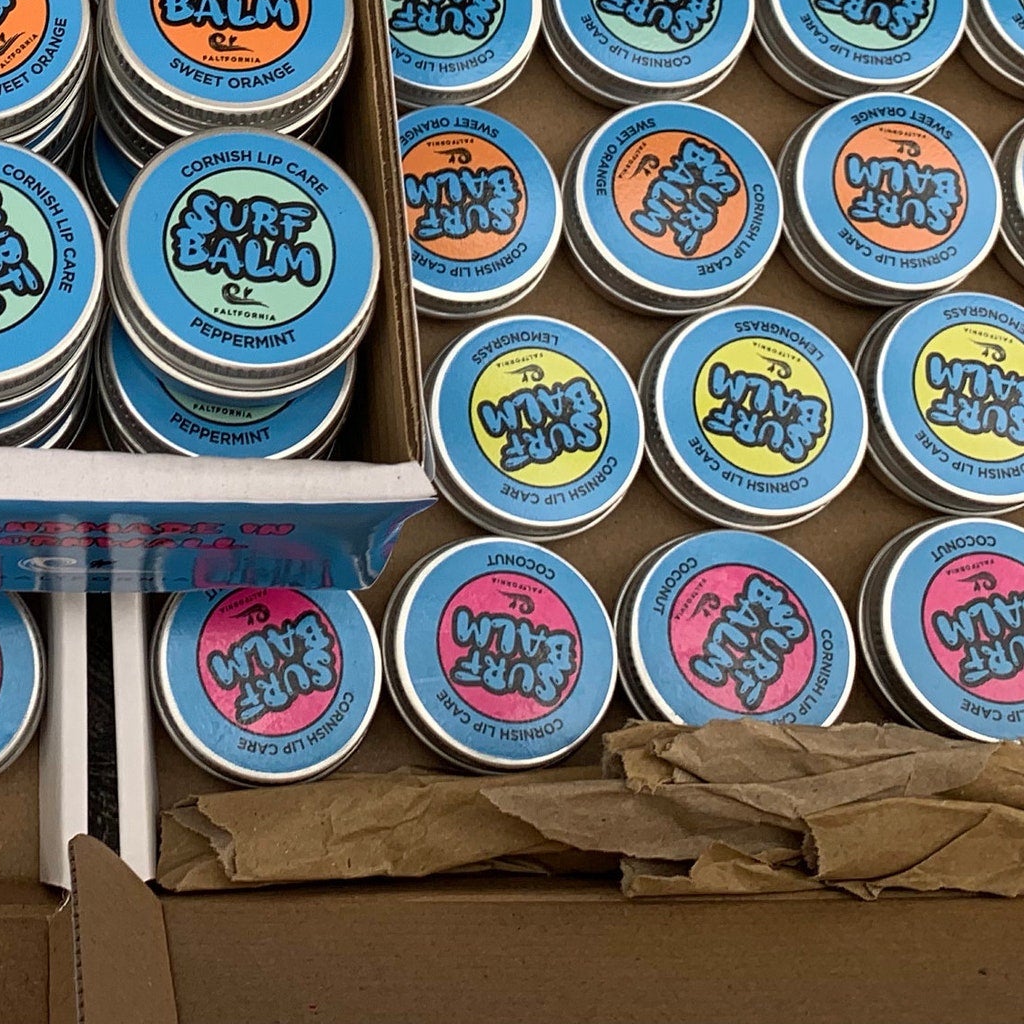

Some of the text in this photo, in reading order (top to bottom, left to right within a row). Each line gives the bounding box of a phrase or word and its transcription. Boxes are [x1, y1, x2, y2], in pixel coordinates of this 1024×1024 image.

[29, 17, 67, 75] ORANGE
[202, 55, 261, 64] FALTFORNIA
[580, 13, 693, 68] CORNISH LIP CARE
[167, 57, 295, 87] SWEET ORANGE
[851, 107, 954, 139] SWEET ORANGE
[178, 148, 329, 195] CORNISH LIP CARE
[844, 154, 960, 204] BALM
[1, 161, 77, 293] CORNISH LIP CARE
[182, 190, 315, 240] SURF
[848, 190, 954, 234] SURF
[173, 225, 320, 284] BALM
[188, 316, 298, 348] PEPPERMINT
[213, 307, 276, 321] FALTFORNIA
[734, 320, 824, 360] LEMONGRASS
[709, 363, 825, 435] BALM
[170, 412, 270, 446] PEPPERMINT
[703, 402, 814, 463] SURF
[239, 522, 296, 536] IN
[485, 553, 557, 581] COCONUT
[451, 607, 574, 672] BALM
[450, 649, 565, 705] SURF
